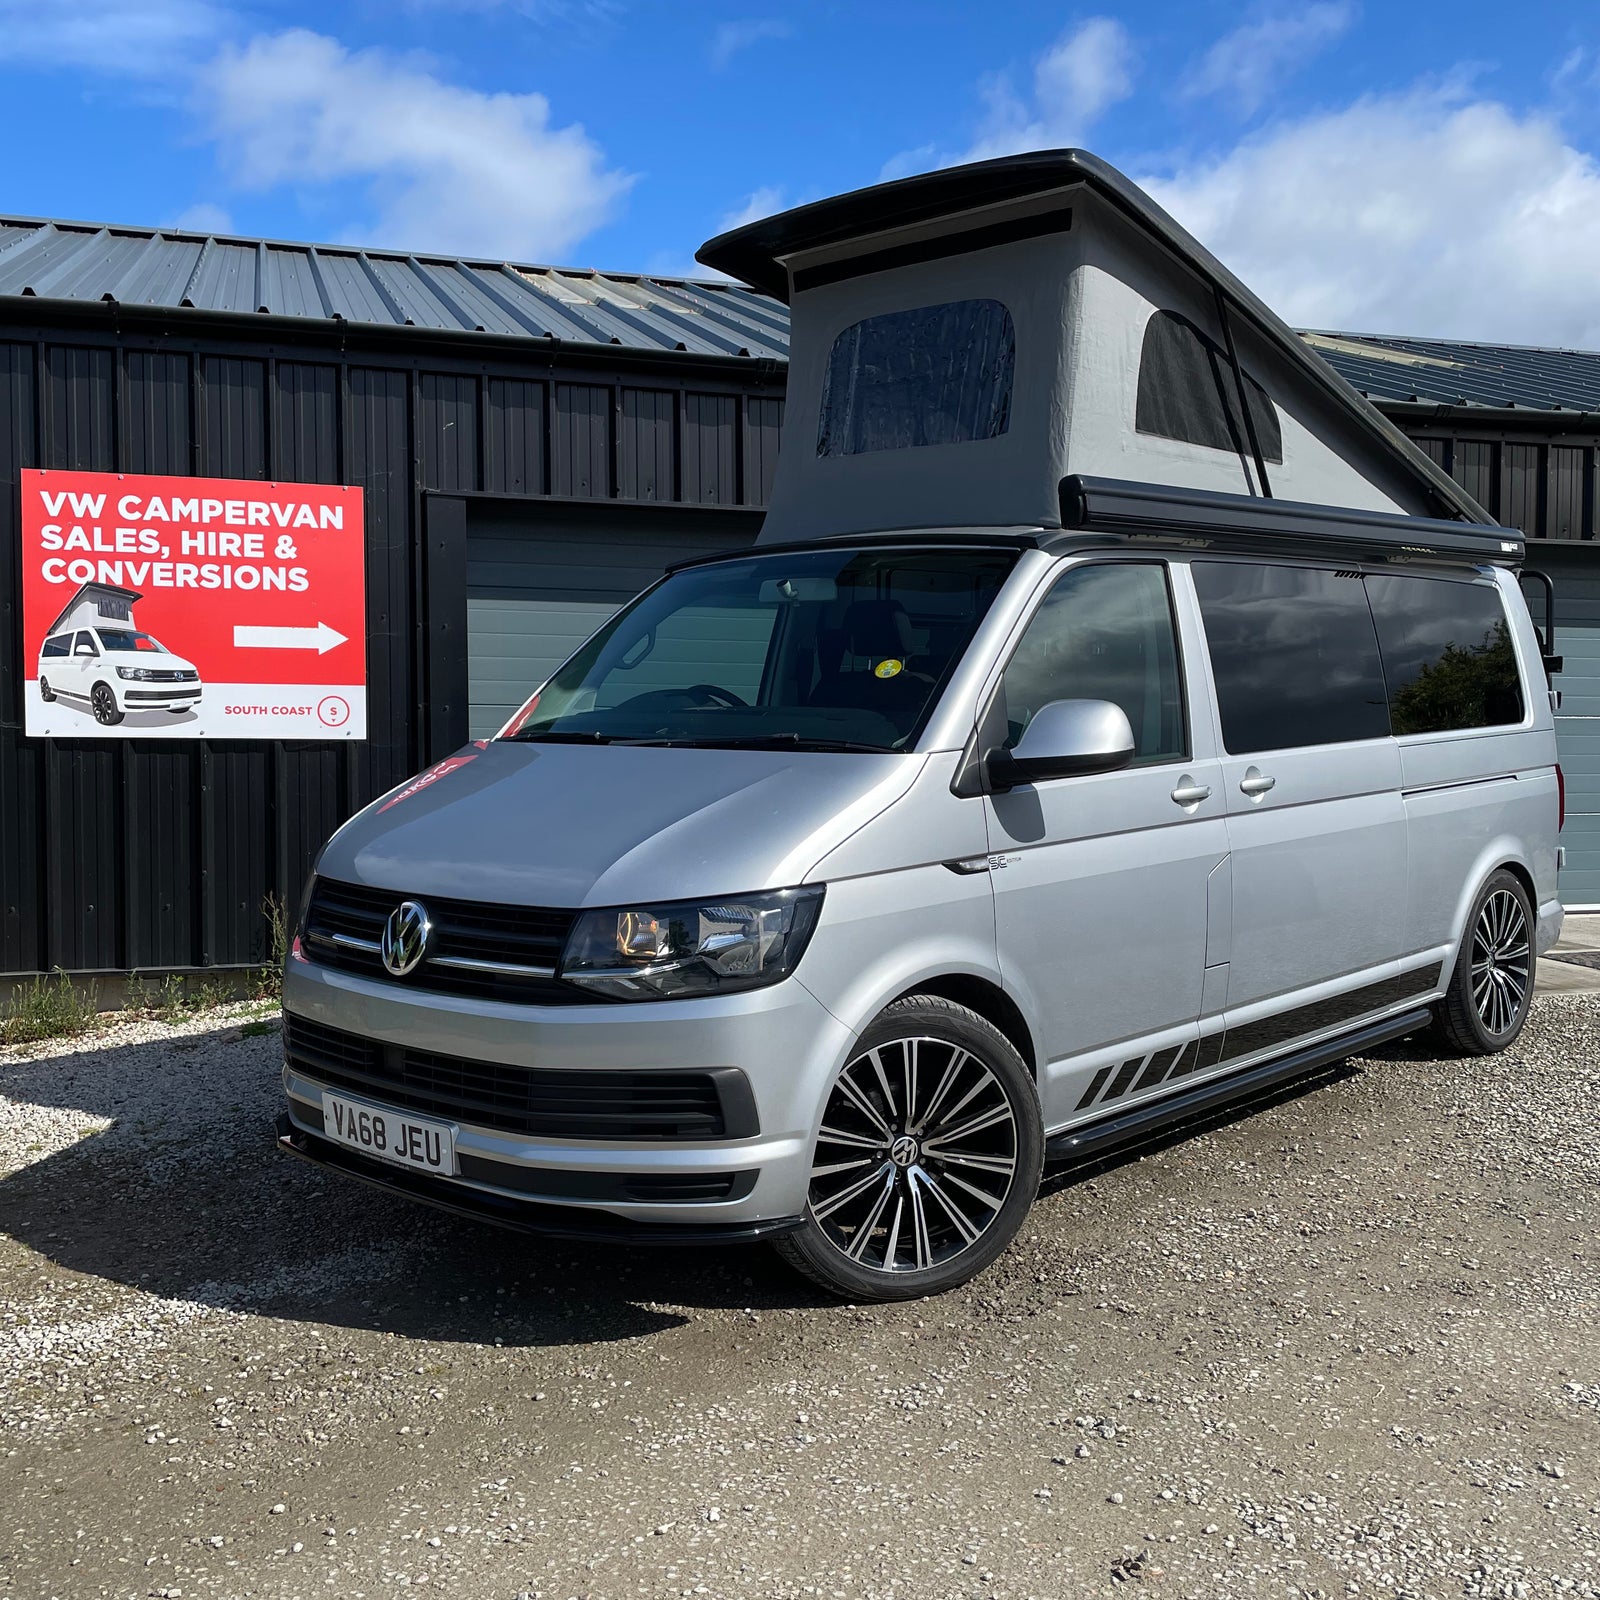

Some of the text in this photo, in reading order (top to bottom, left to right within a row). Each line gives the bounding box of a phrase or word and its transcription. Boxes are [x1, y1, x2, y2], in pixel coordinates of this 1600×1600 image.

[40, 491, 344, 530] VW CAMPERVAN
[40, 525, 298, 559] SALES, HIRE &
[41, 559, 309, 592] CONVERSIONS
[224, 706, 313, 715] SOUTH COAST
[333, 1101, 387, 1151] VA68
[394, 1123, 441, 1167] JEU
